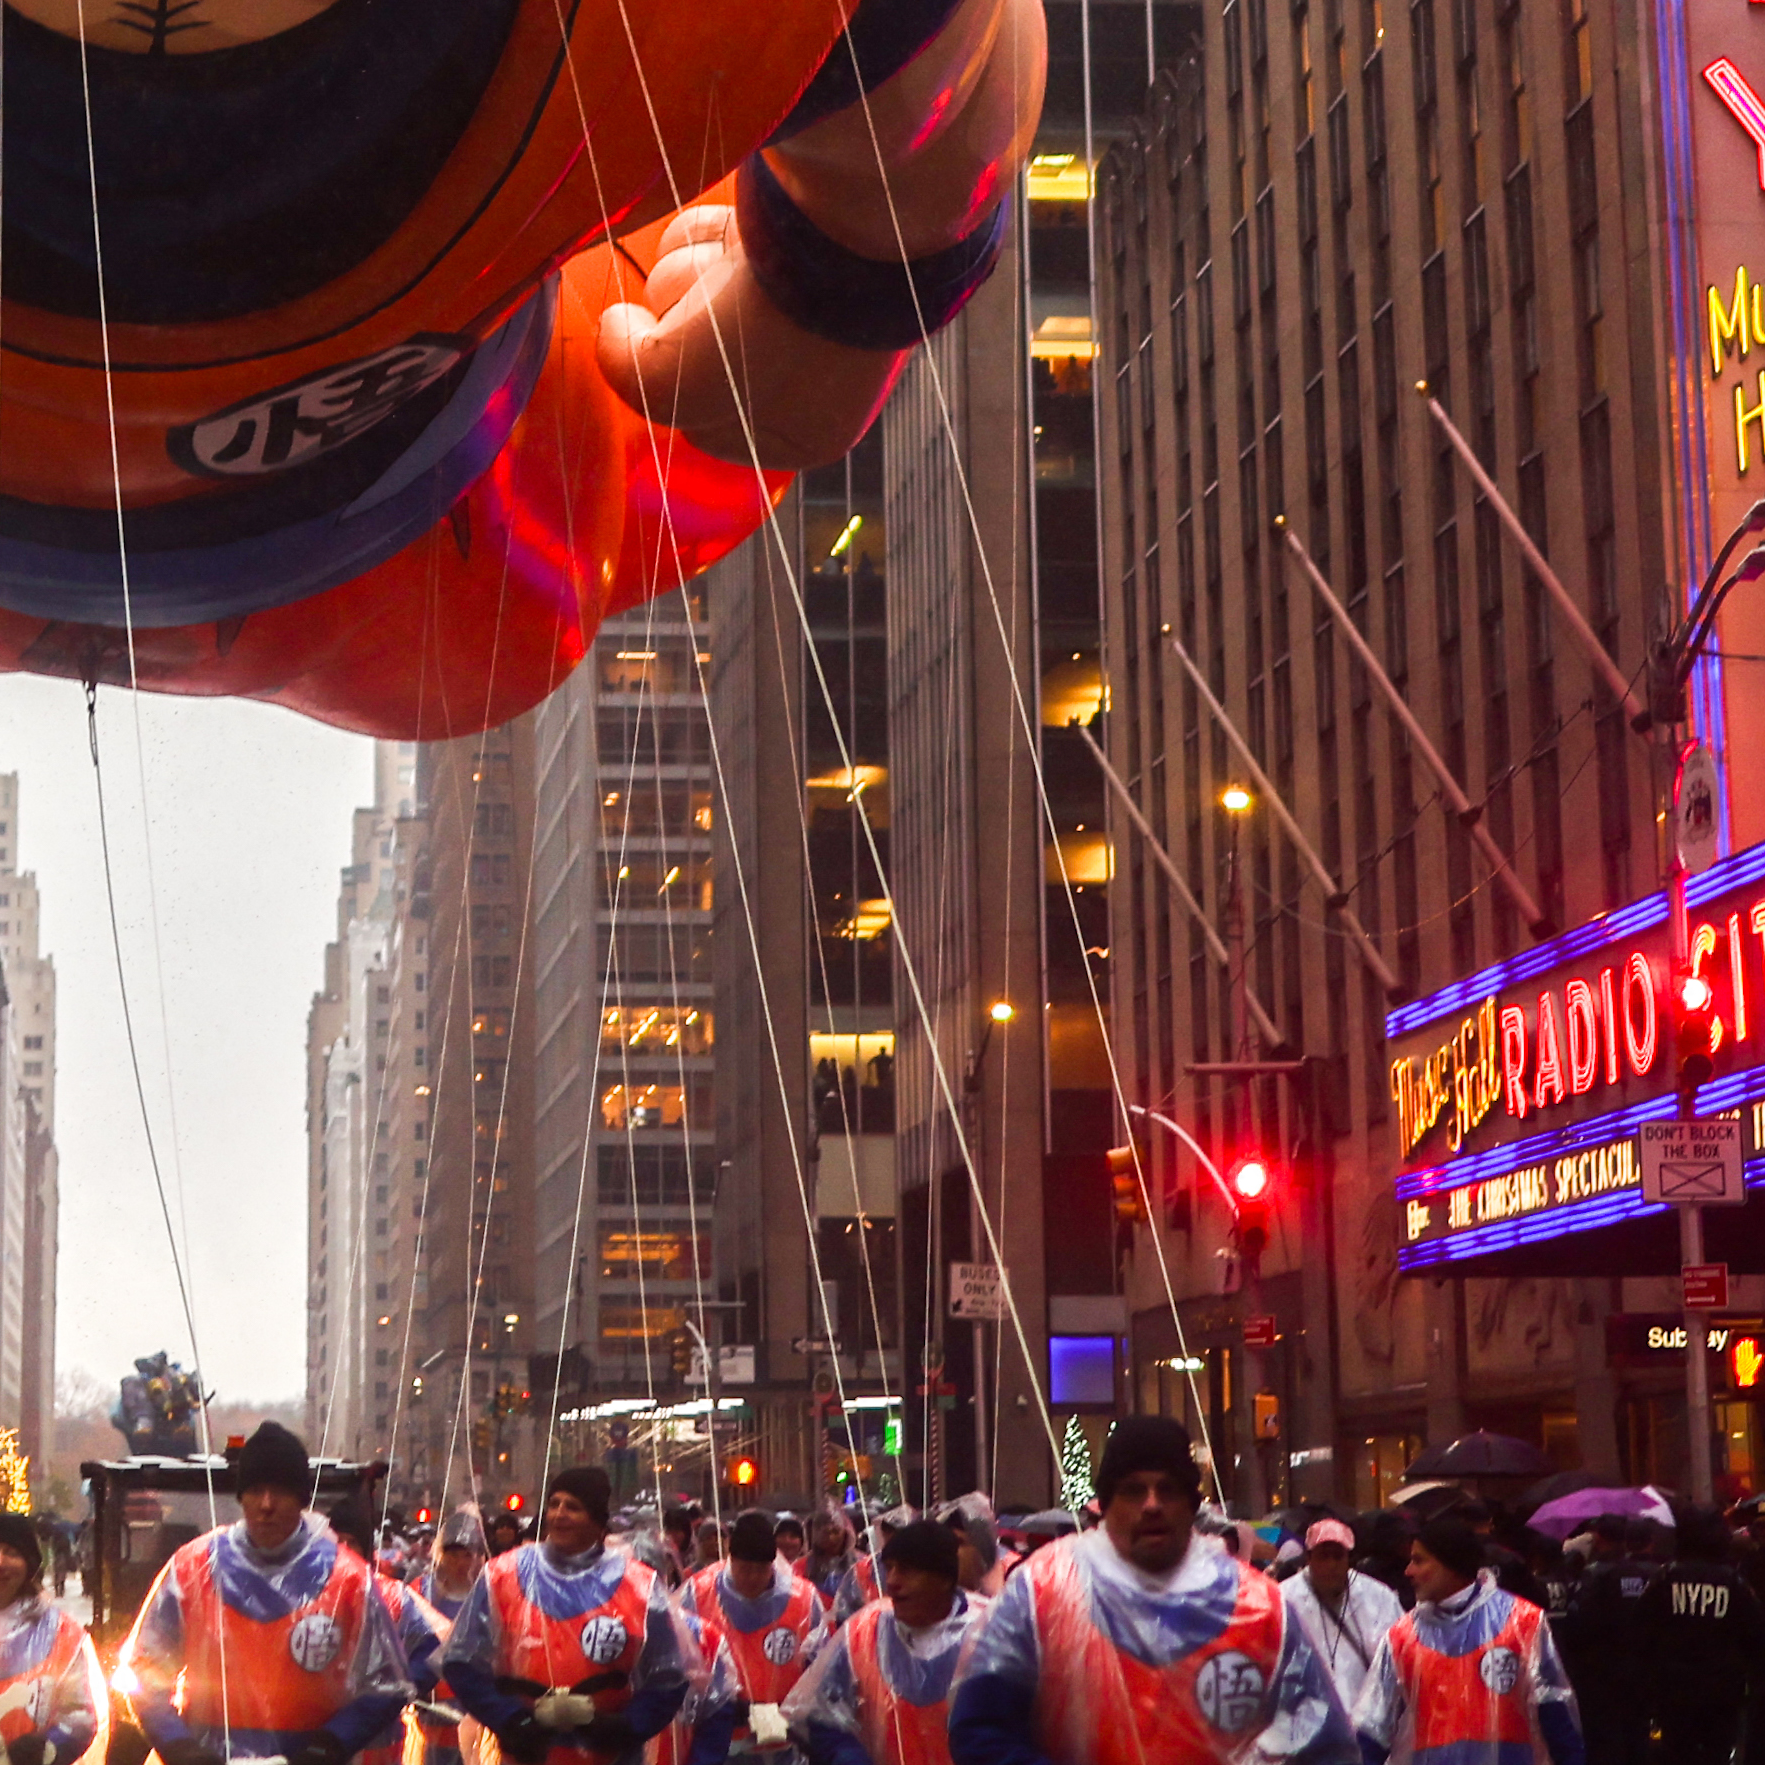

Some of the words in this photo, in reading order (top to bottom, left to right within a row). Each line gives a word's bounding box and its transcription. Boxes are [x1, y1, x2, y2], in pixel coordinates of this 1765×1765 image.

[1500, 951, 1658, 1119] RADIO
[1645, 1124, 1684, 1142] DON'T
[1690, 1124, 1735, 1141] BLOCK
[1663, 1143, 1687, 1159] THE
[1693, 1142, 1721, 1159] BOX
[1554, 1138, 1641, 1204] SPECTACUL
[964, 1282, 996, 1296] ONLY
[1647, 1325, 1729, 1353] Subay
[1671, 1581, 1731, 1620] NYPD
